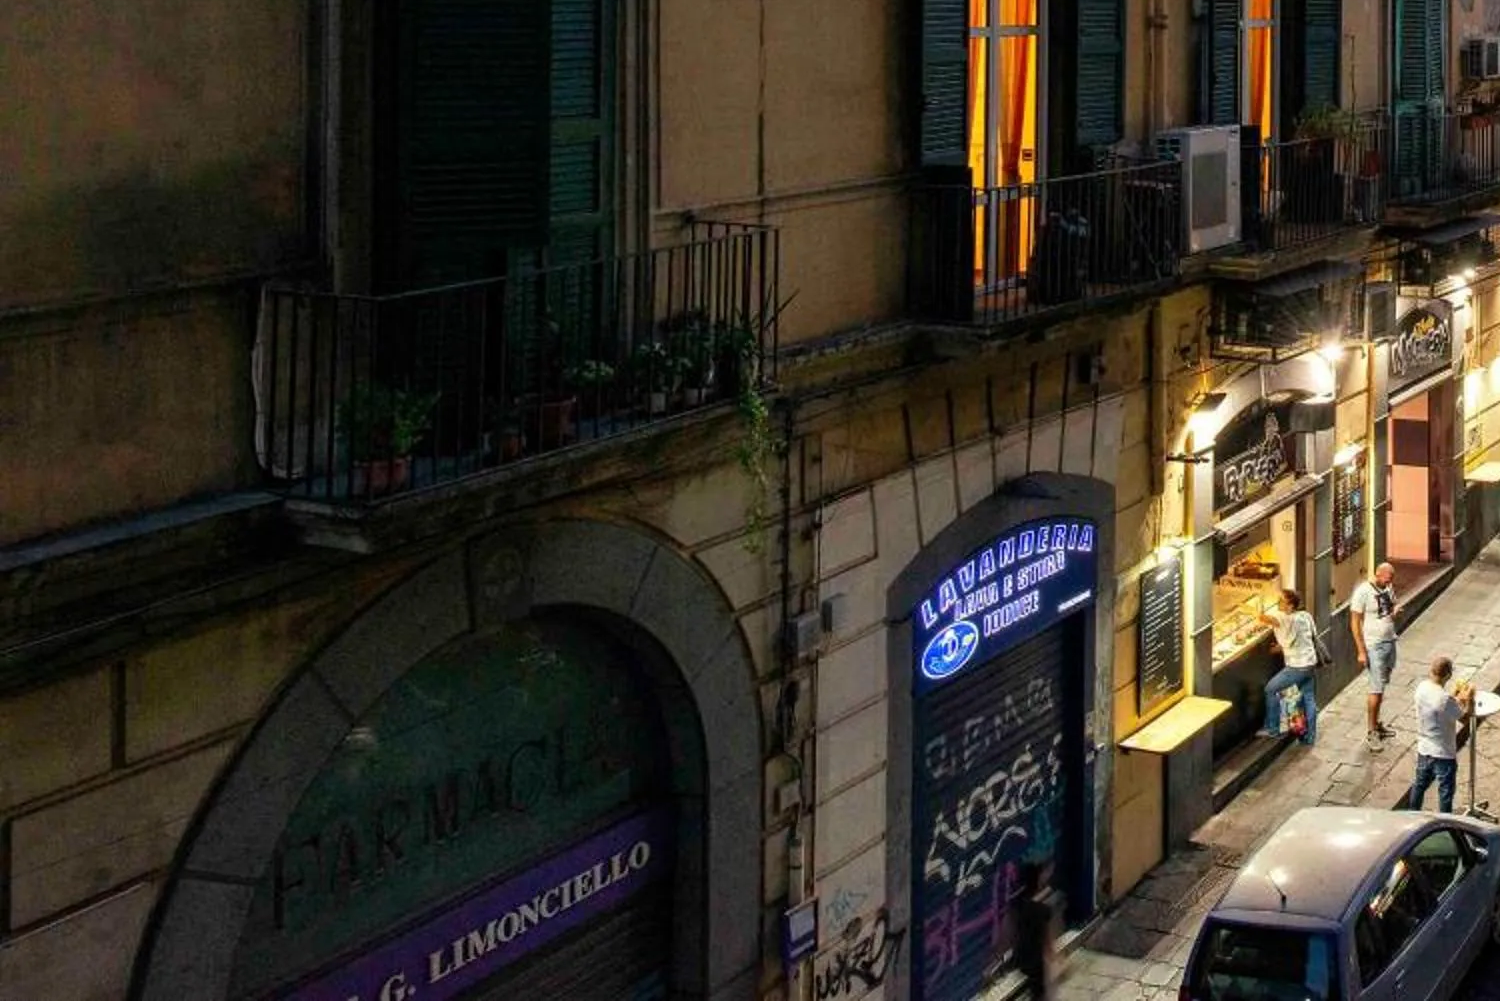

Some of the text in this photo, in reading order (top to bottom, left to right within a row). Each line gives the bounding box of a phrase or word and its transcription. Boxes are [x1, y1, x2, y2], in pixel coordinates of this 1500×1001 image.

[921, 524, 1094, 629] LAVANDERIA
[272, 719, 624, 931] FARMACI
[428, 840, 652, 984] LIMONCIELLO
